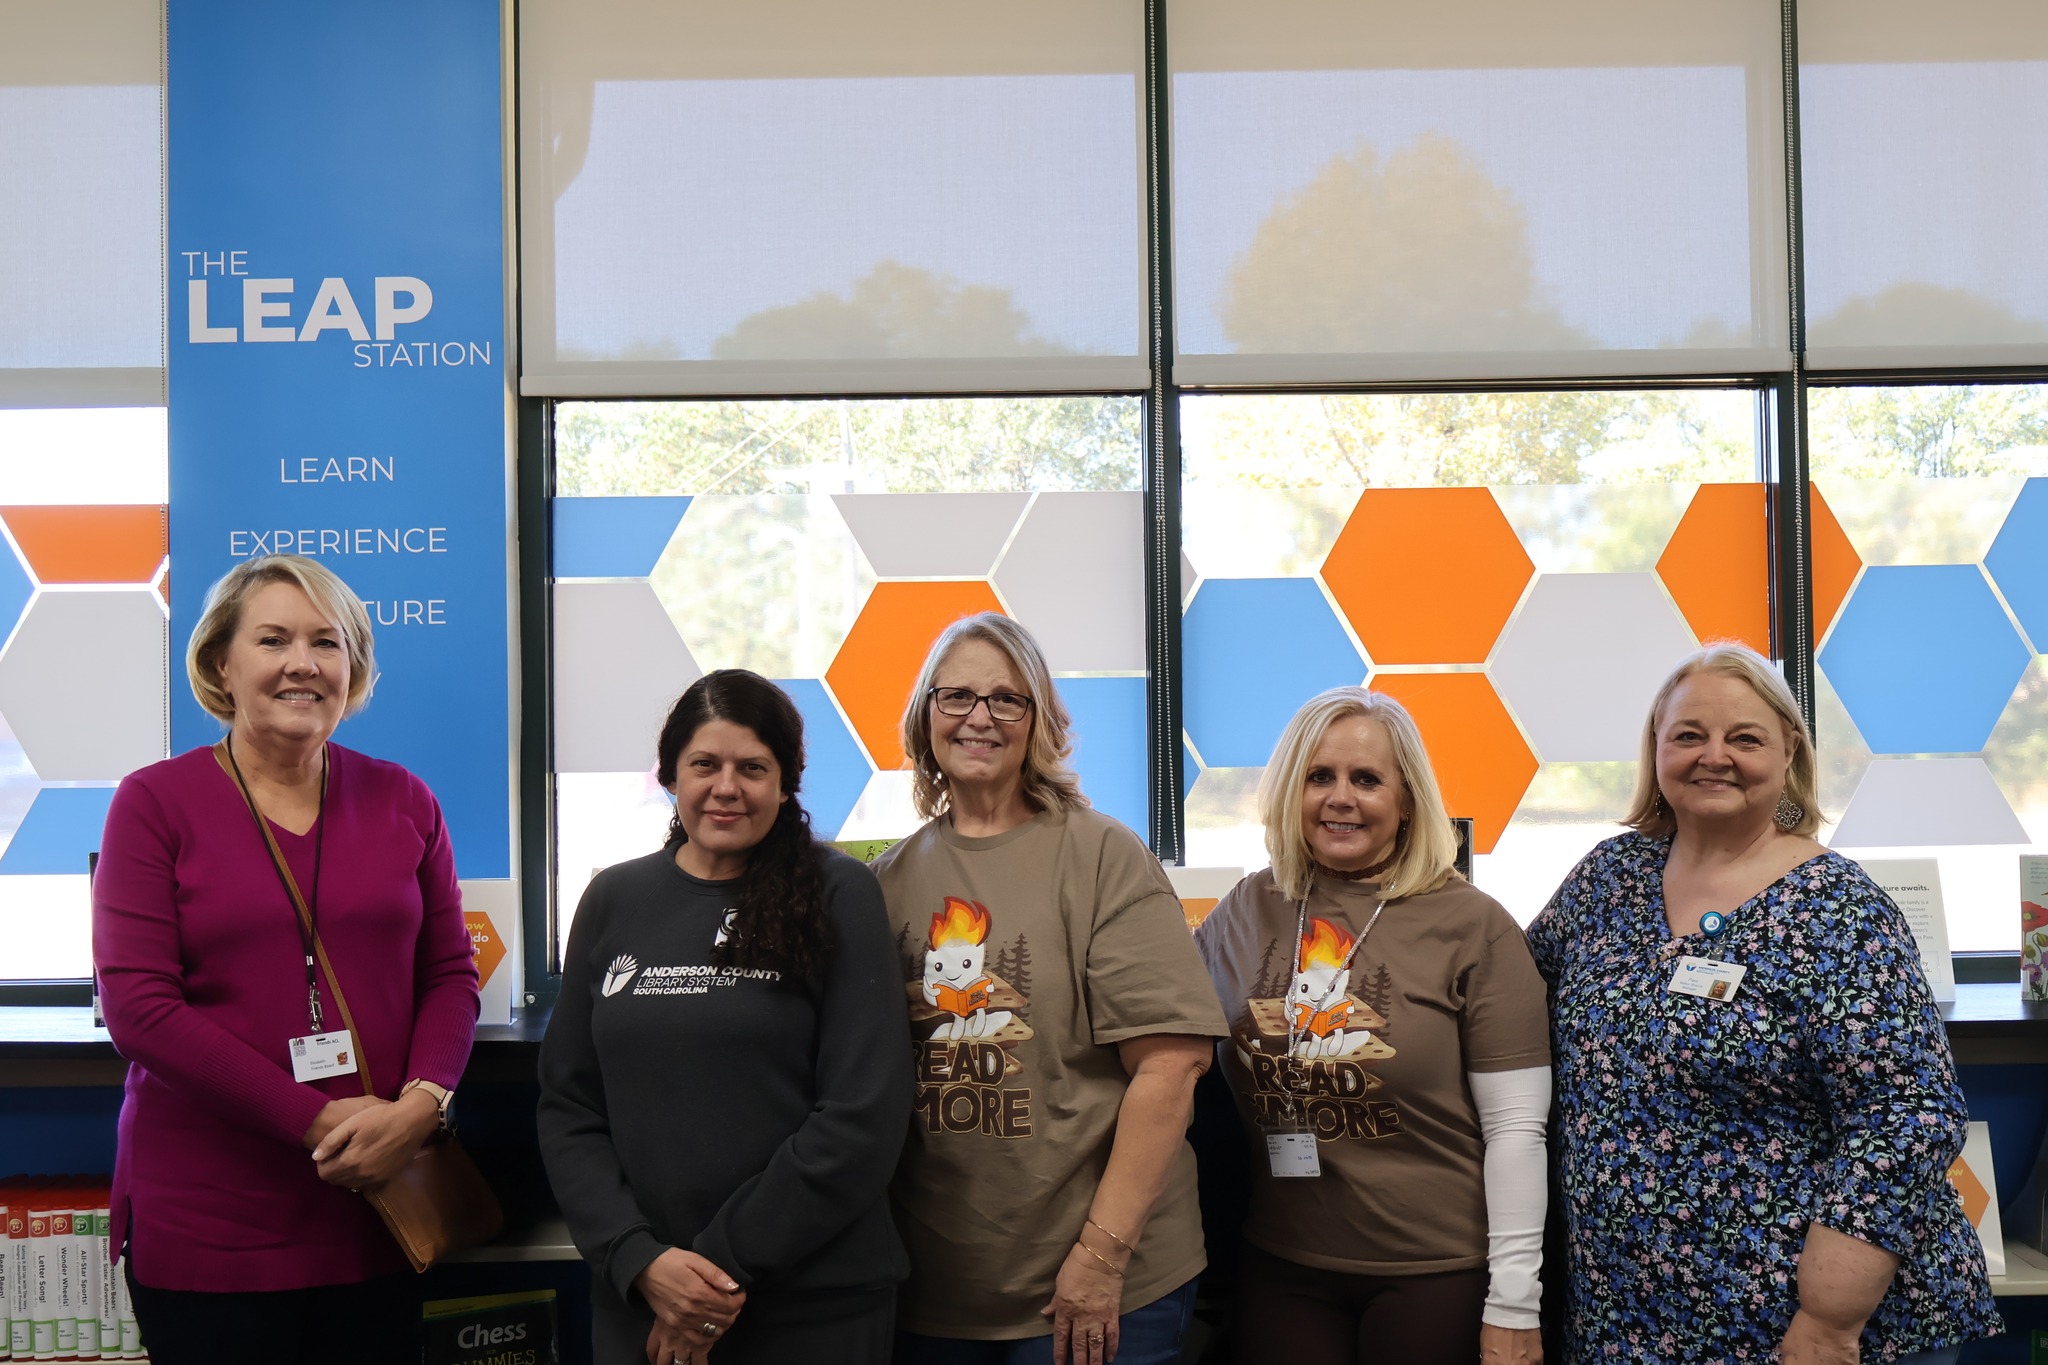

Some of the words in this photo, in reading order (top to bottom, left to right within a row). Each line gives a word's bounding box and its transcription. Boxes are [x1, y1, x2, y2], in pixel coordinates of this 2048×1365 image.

[181, 251, 249, 276] THE
[188, 276, 433, 344] LEAP
[353, 341, 492, 368] STATION
[280, 456, 394, 483] LEARN
[229, 527, 448, 556] EXPERIENCE
[1901, 883, 1930, 892] awaits.
[636, 977, 687, 988] LIBRARY
[687, 976, 737, 987] SYSTEM
[641, 966, 718, 977] ANDERSON
[721, 966, 783, 982] COUNTY
[632, 987, 663, 995] SOUTH
[664, 986, 708, 995] CAROLINA
[1250, 1052, 1368, 1099] READ
[39, 1280, 47, 1303] Song!
[457, 1322, 527, 1349] Chess
